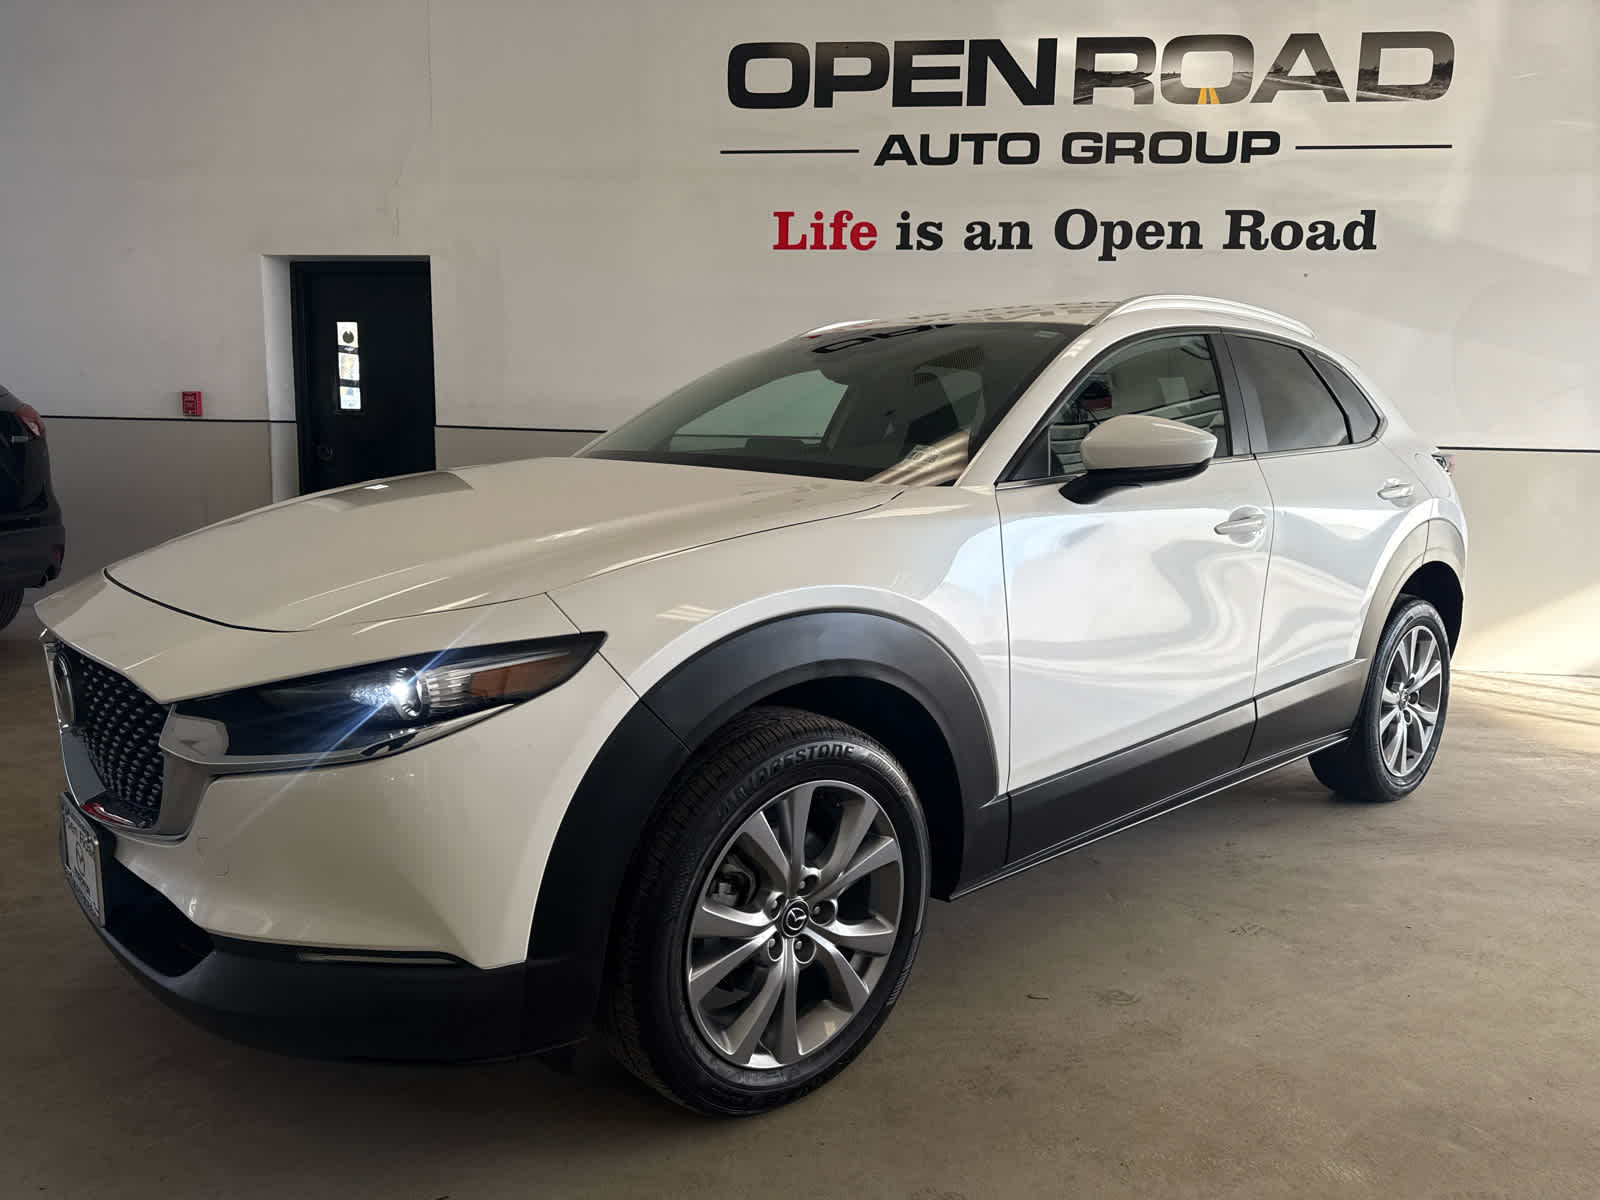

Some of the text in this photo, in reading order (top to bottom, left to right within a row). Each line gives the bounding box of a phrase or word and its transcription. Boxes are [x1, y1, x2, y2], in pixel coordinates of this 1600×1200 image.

[728, 31, 1454, 109] OPEN ROAD
[874, 131, 1280, 166] AUTO GROUP
[773, 209, 1377, 261] Life is an Open Road
